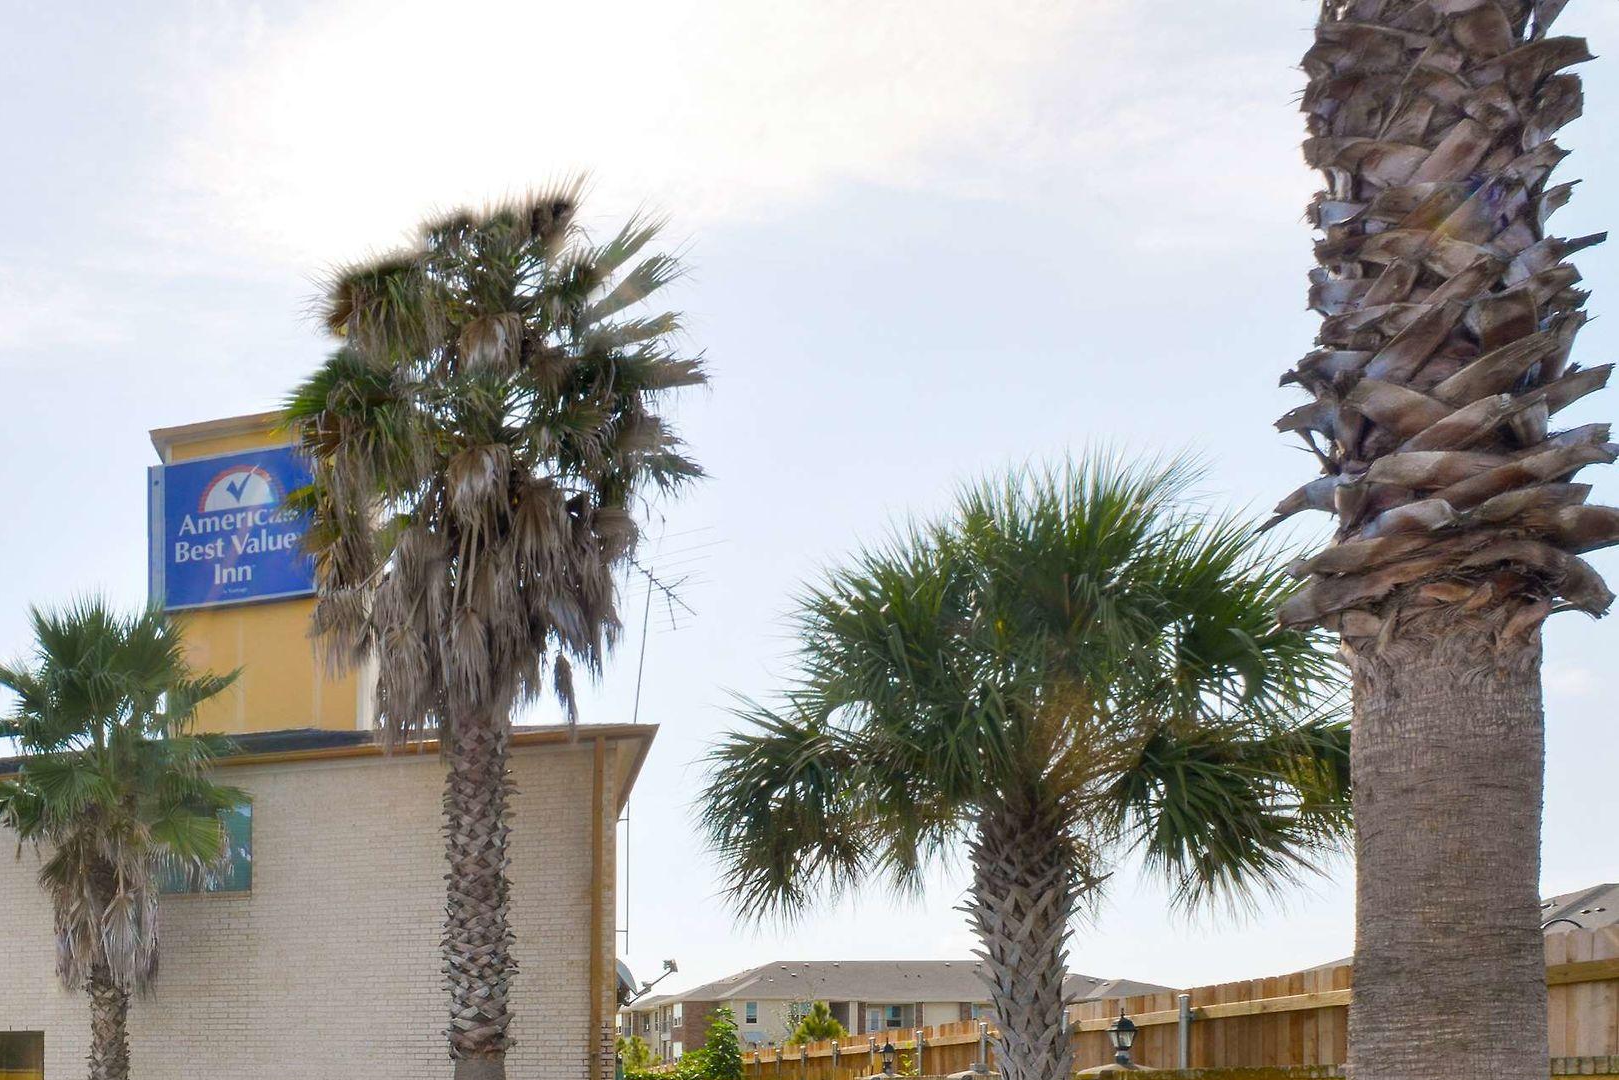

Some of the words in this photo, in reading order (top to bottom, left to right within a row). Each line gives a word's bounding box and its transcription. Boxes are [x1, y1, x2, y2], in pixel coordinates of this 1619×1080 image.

[174, 539, 225, 563] Best
[230, 528, 297, 556] Value
[214, 563, 252, 585] Inn
